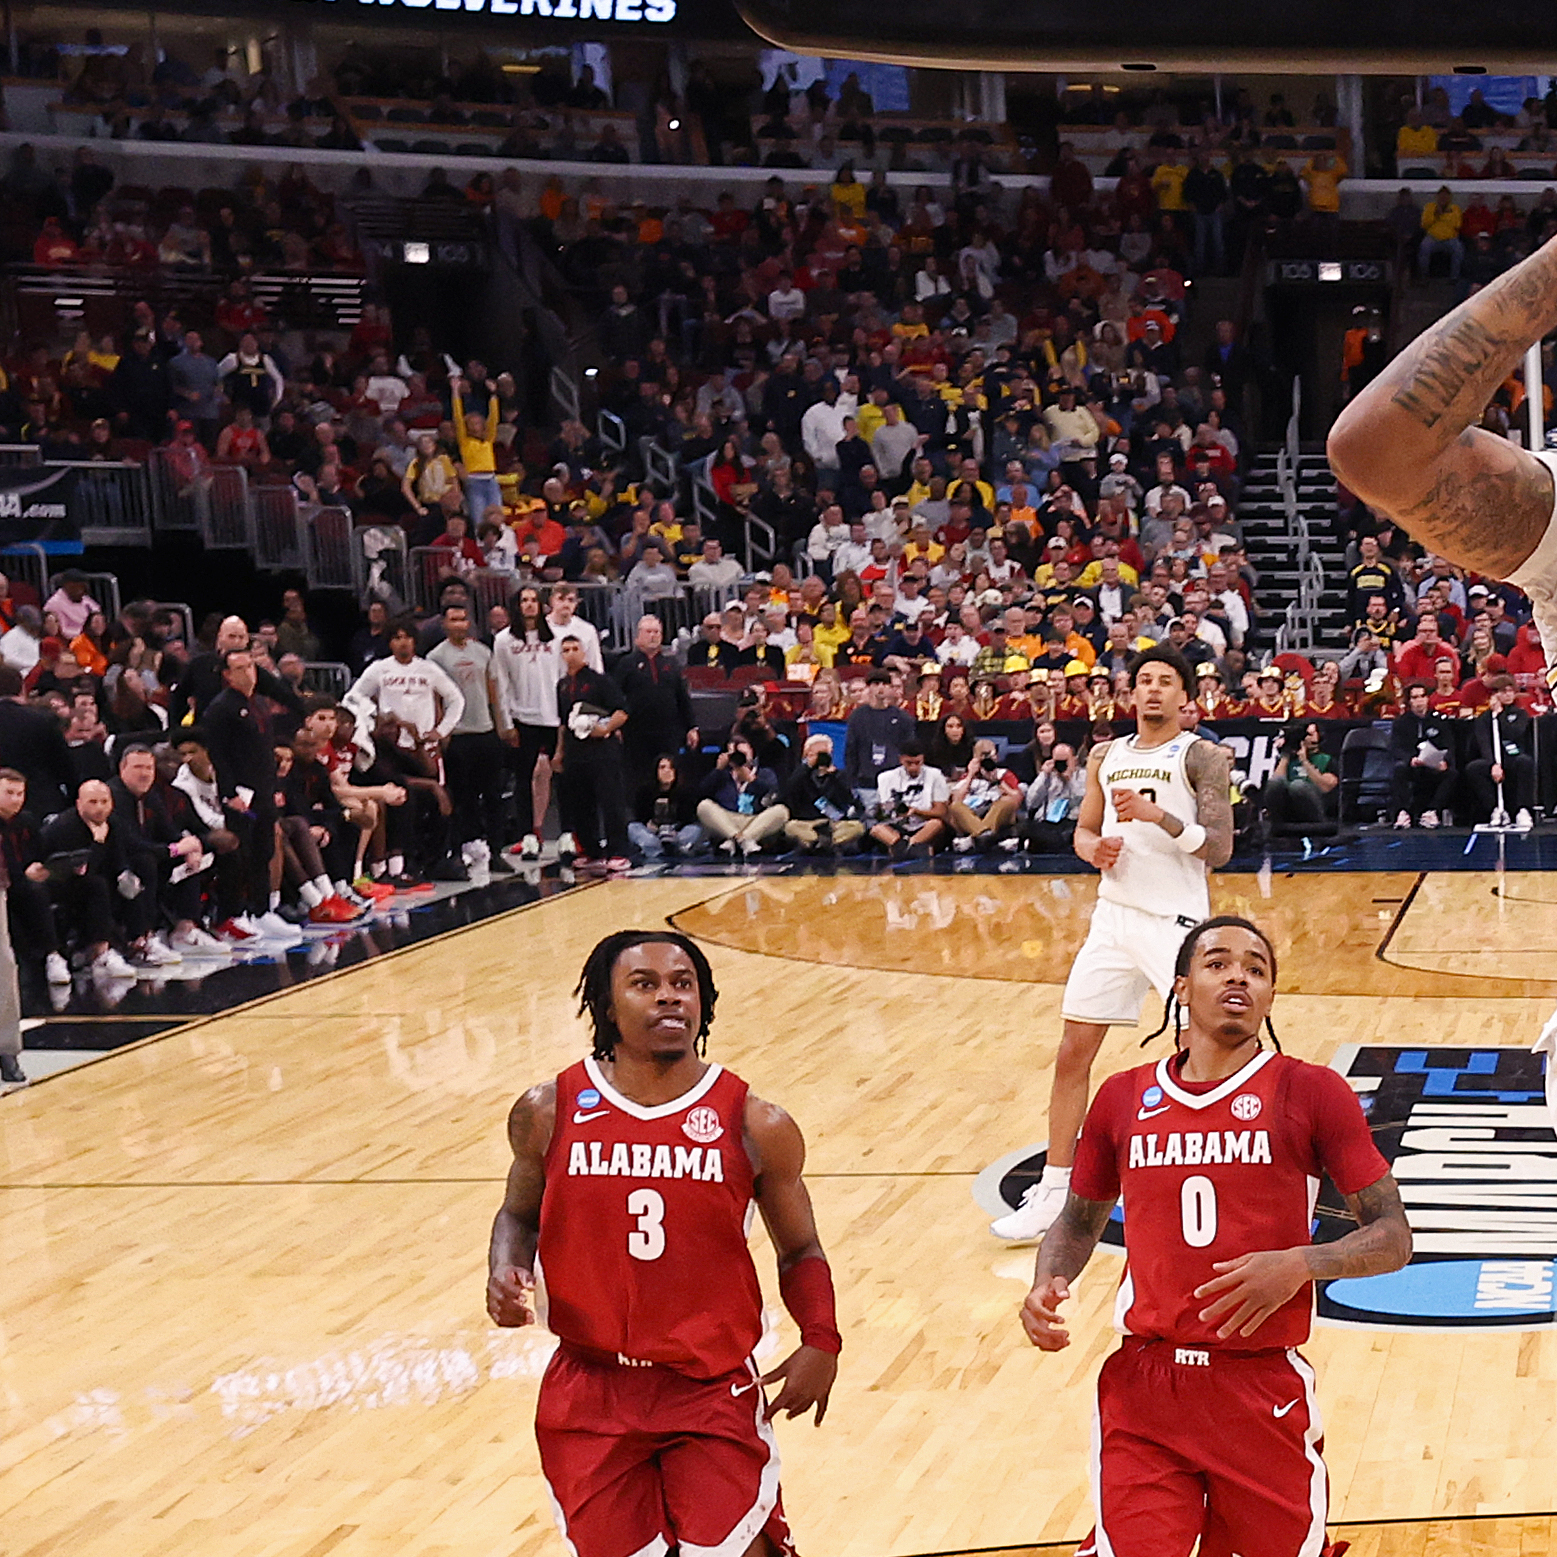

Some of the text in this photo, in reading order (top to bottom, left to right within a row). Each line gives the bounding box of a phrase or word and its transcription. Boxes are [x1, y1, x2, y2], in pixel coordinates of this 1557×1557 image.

[1106, 768, 1172, 786] MICHIGAN
[689, 1108, 718, 1135] SEC
[1233, 1095, 1261, 1120] SEC
[568, 1141, 723, 1183] ALABAMA
[1129, 1130, 1272, 1168] ALABAMA
[627, 1188, 665, 1261] 3
[1180, 1175, 1218, 1248] 0
[1174, 1348, 1211, 1367] RTR
